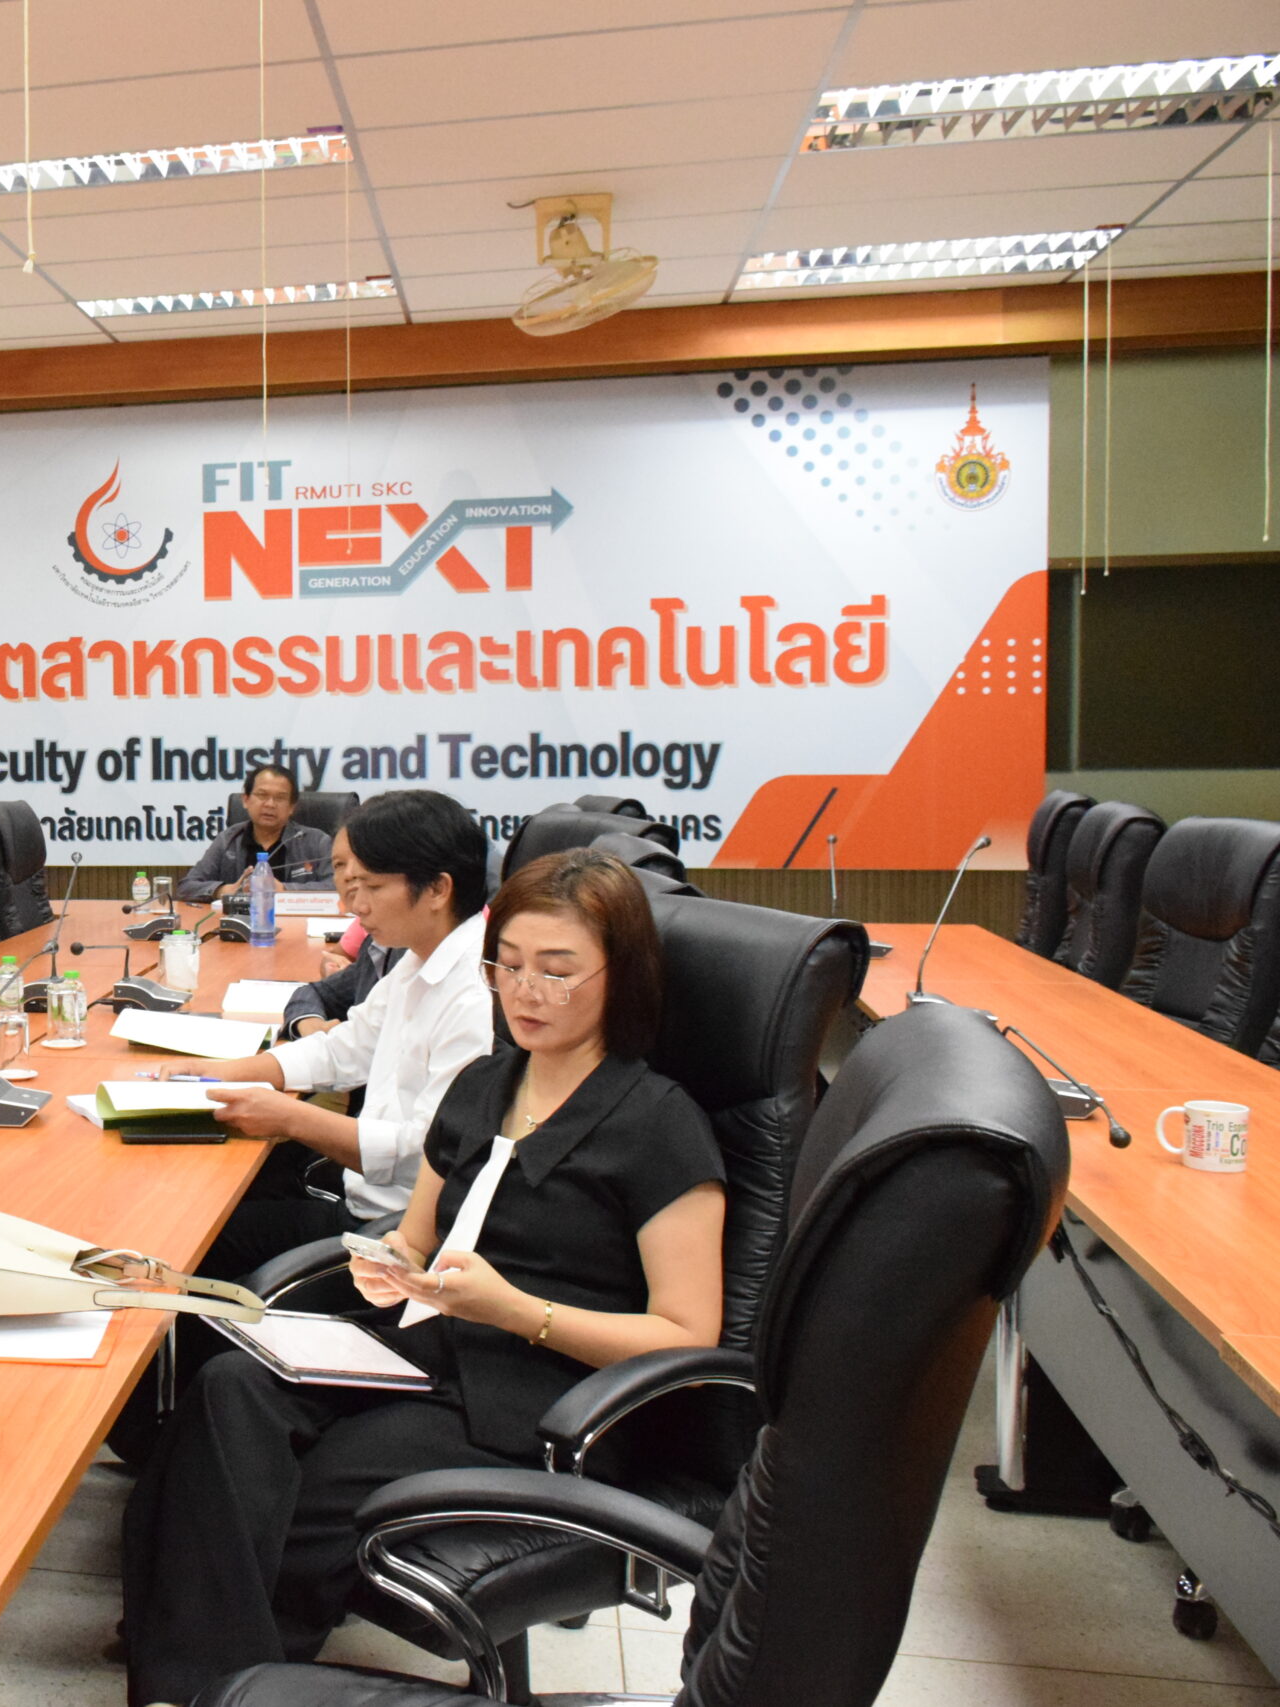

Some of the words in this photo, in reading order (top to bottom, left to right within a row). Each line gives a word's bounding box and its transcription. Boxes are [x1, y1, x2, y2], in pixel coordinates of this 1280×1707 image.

[202, 460, 292, 503] FIT
[295, 484, 361, 500] RMUTI
[371, 481, 413, 497] SKC
[465, 504, 552, 519] INNOVATION
[398, 514, 459, 576] EDUCATION
[308, 575, 391, 589] GENERATION
[97, 737, 141, 782] of
[151, 736, 331, 791] Industry
[341, 733, 427, 780] and
[438, 731, 722, 790] Technology
